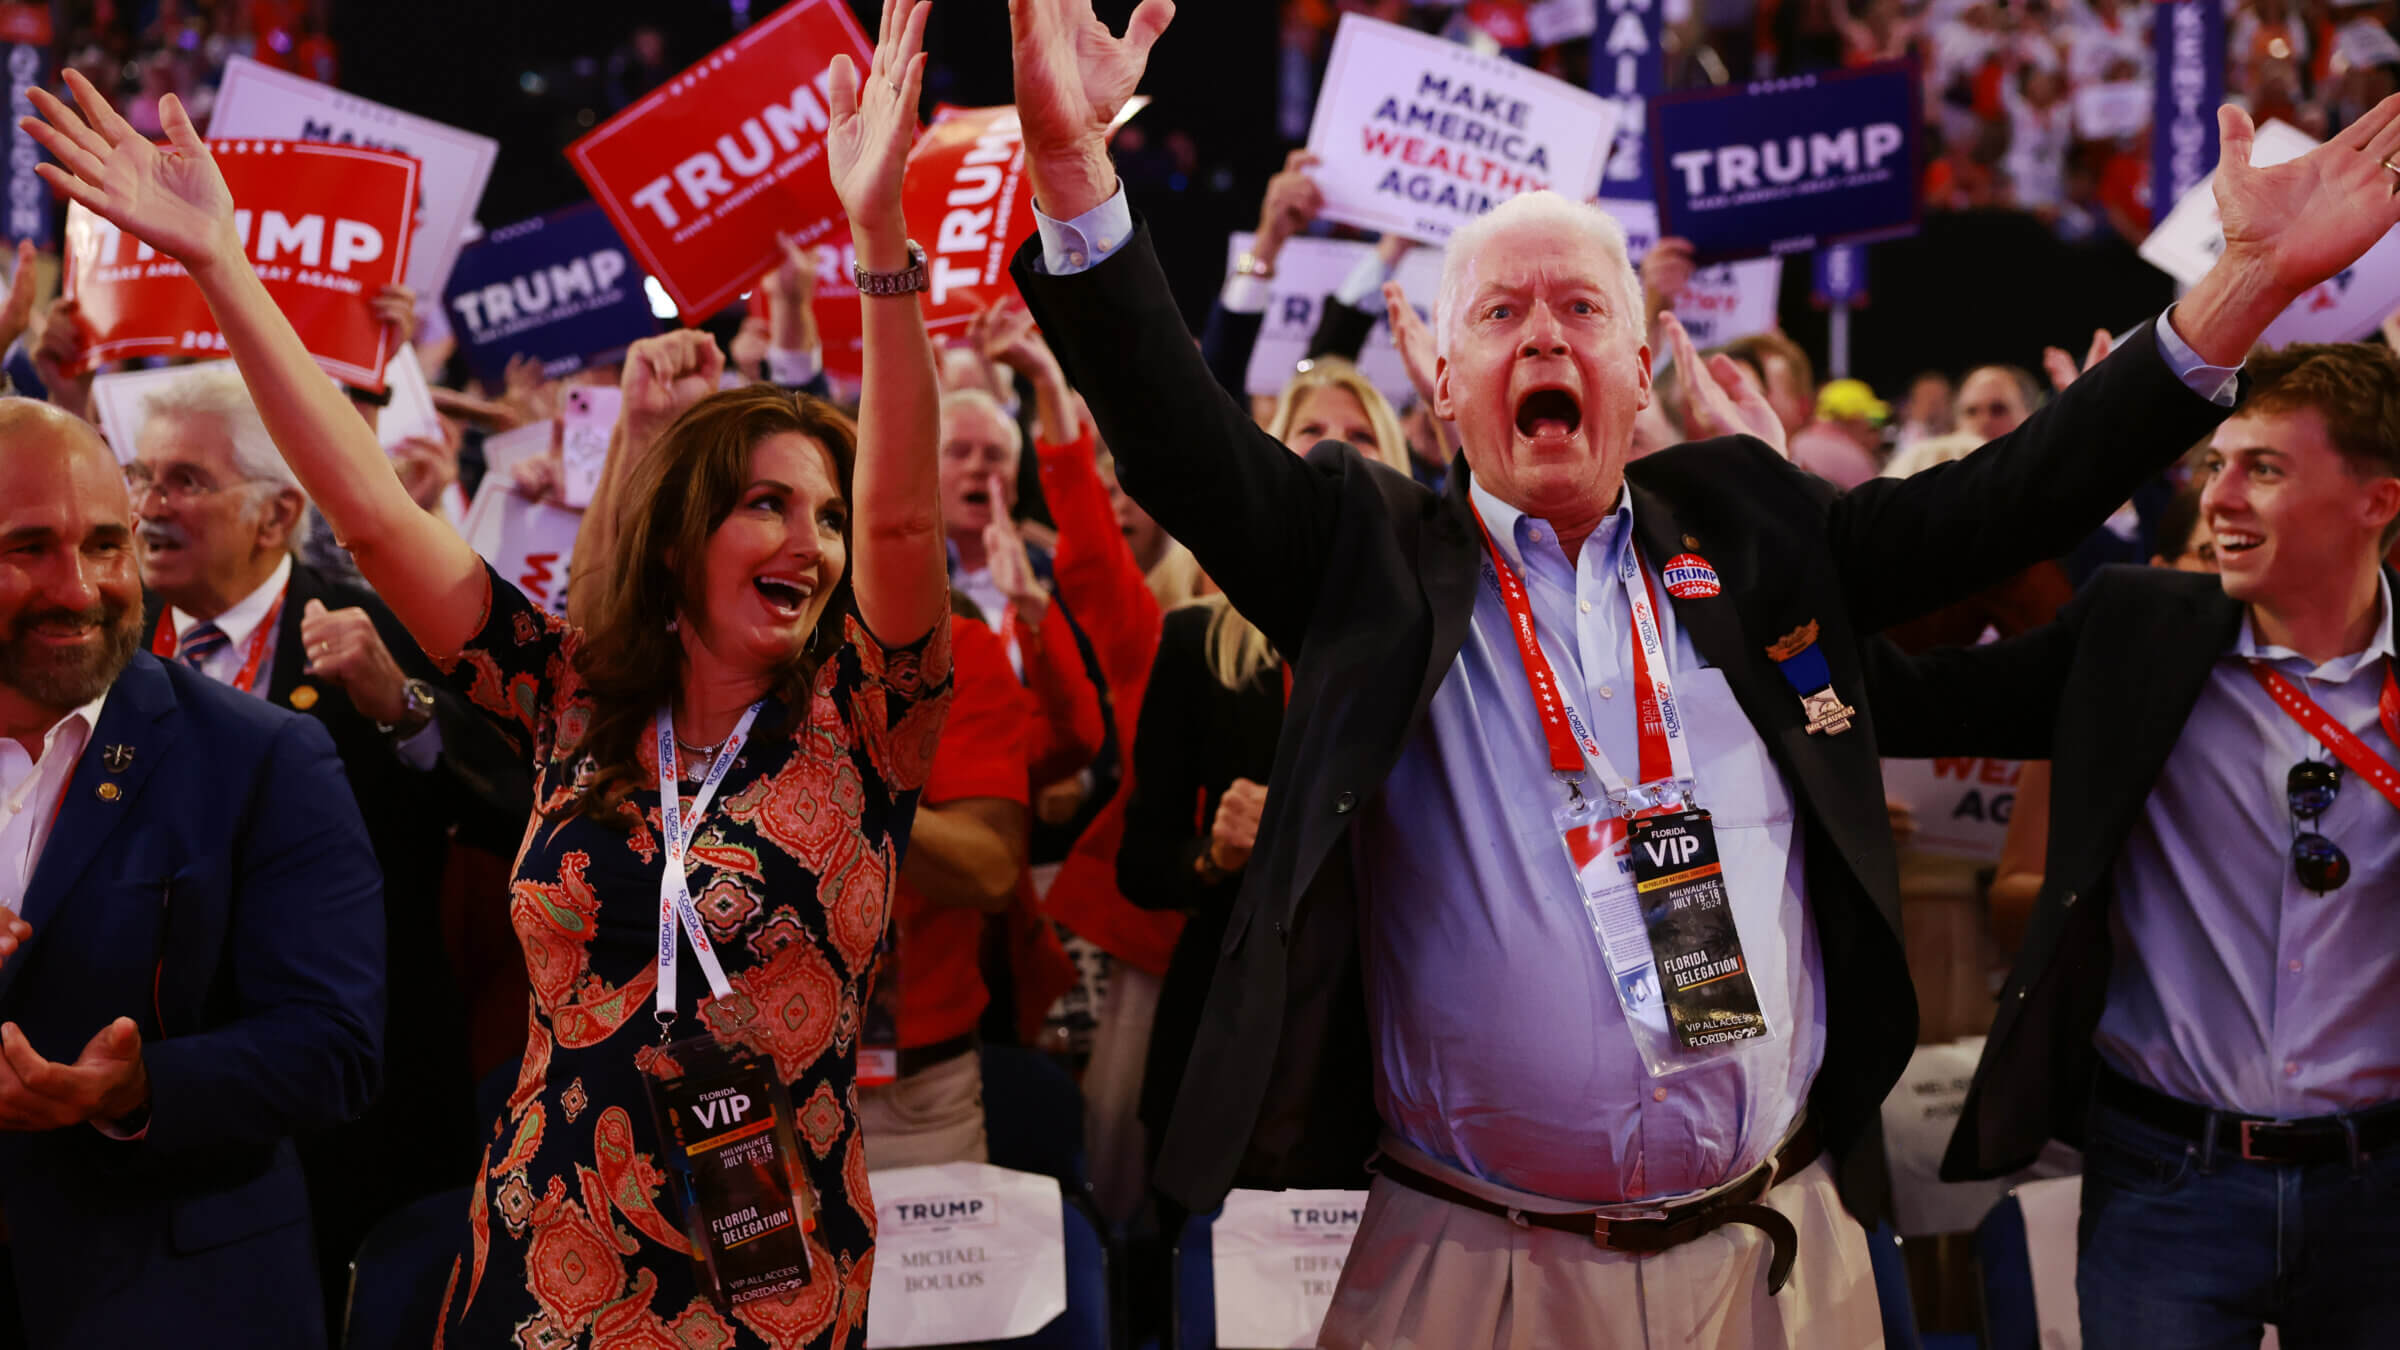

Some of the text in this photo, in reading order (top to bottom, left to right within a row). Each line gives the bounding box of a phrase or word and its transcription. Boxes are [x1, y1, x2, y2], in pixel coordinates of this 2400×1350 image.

[1417, 71, 1531, 129] MAKE
[1374, 97, 1549, 173] AMERICA
[1671, 122, 1902, 196] TRUMP
[453, 248, 626, 334] TRUMP
[1665, 567, 1717, 584] TRUMP
[1683, 585, 1713, 597] 2024
[1651, 826, 1686, 839] FLORIDA
[1642, 835, 1700, 868] VIP
[1669, 880, 1717, 899] MILWAUKEE
[1672, 889, 1720, 910] JULY 15-18
[1700, 898, 1721, 911] 2024
[1664, 950, 1708, 974] FLORIDA
[1674, 956, 1738, 987] DELEGATION
[1685, 1022, 1701, 1033] VIP
[1703, 1019, 1719, 1030] ALL
[699, 1086, 737, 1102] FLORIDA
[691, 1094, 751, 1129] VIP
[720, 1134, 769, 1159] MILWAUKEE
[723, 1143, 773, 1169] JULY 15-18
[712, 1206, 758, 1232] FLORIDA
[896, 1199, 983, 1221] TRUMP
[722, 1209, 789, 1245] DELEGATION
[902, 1247, 991, 1268] MICHAEL
[729, 1265, 800, 1289] VIP ALL ACCESS
[904, 1271, 985, 1293] BOULOS
